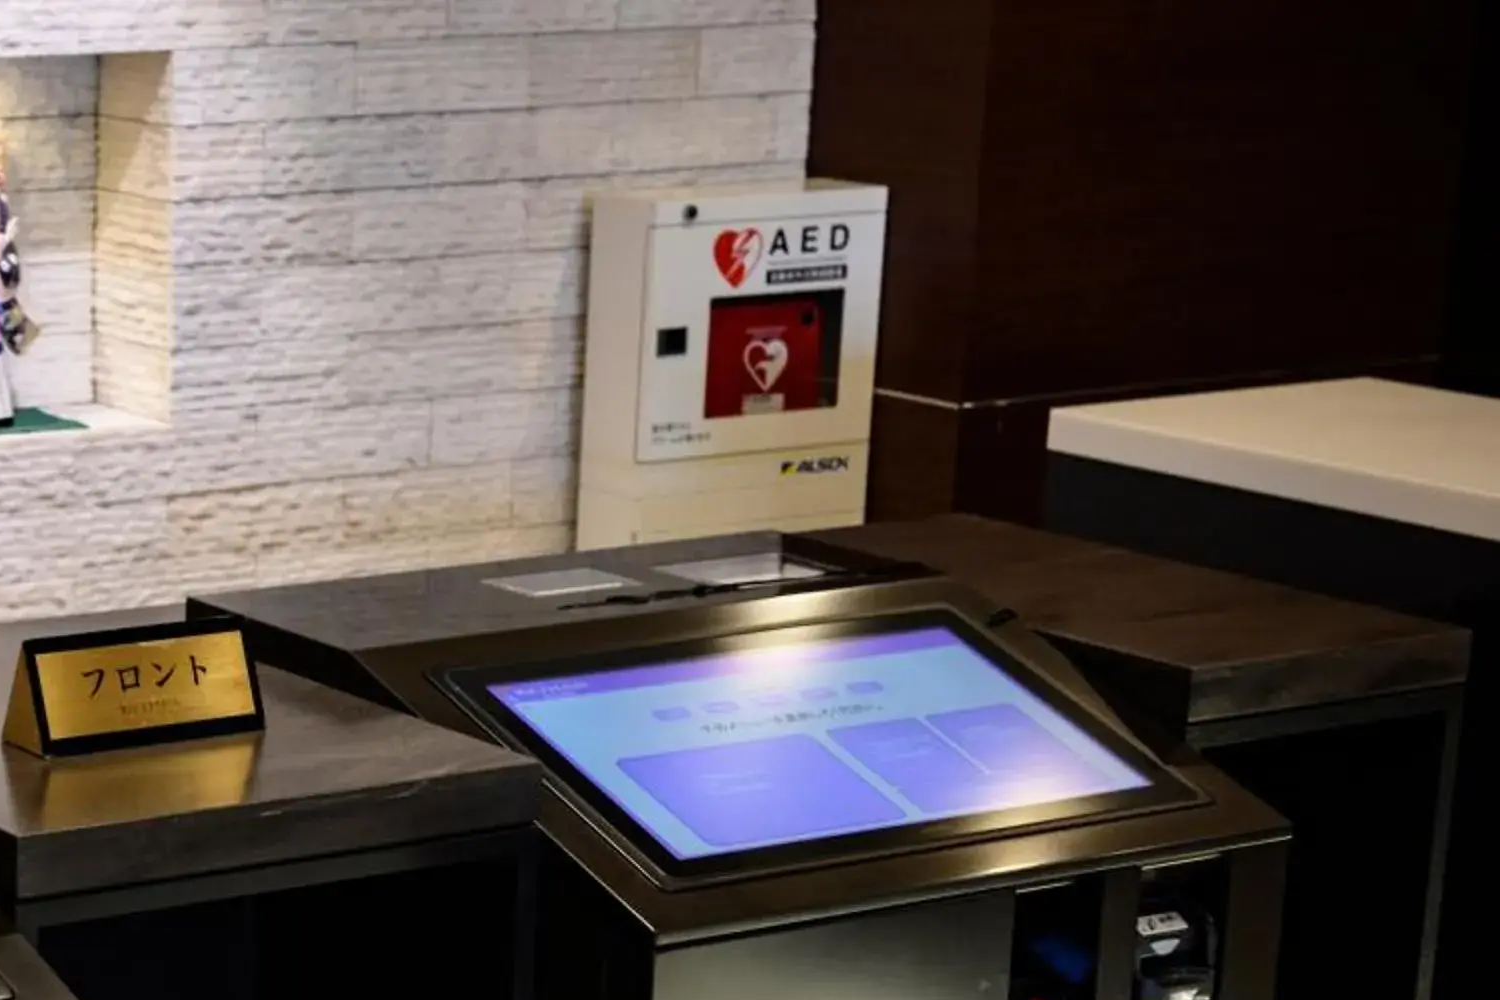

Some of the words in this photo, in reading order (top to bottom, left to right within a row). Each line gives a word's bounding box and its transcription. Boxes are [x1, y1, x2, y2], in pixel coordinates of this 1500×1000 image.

[768, 223, 850, 256] AED
[82, 654, 208, 700] フロント
